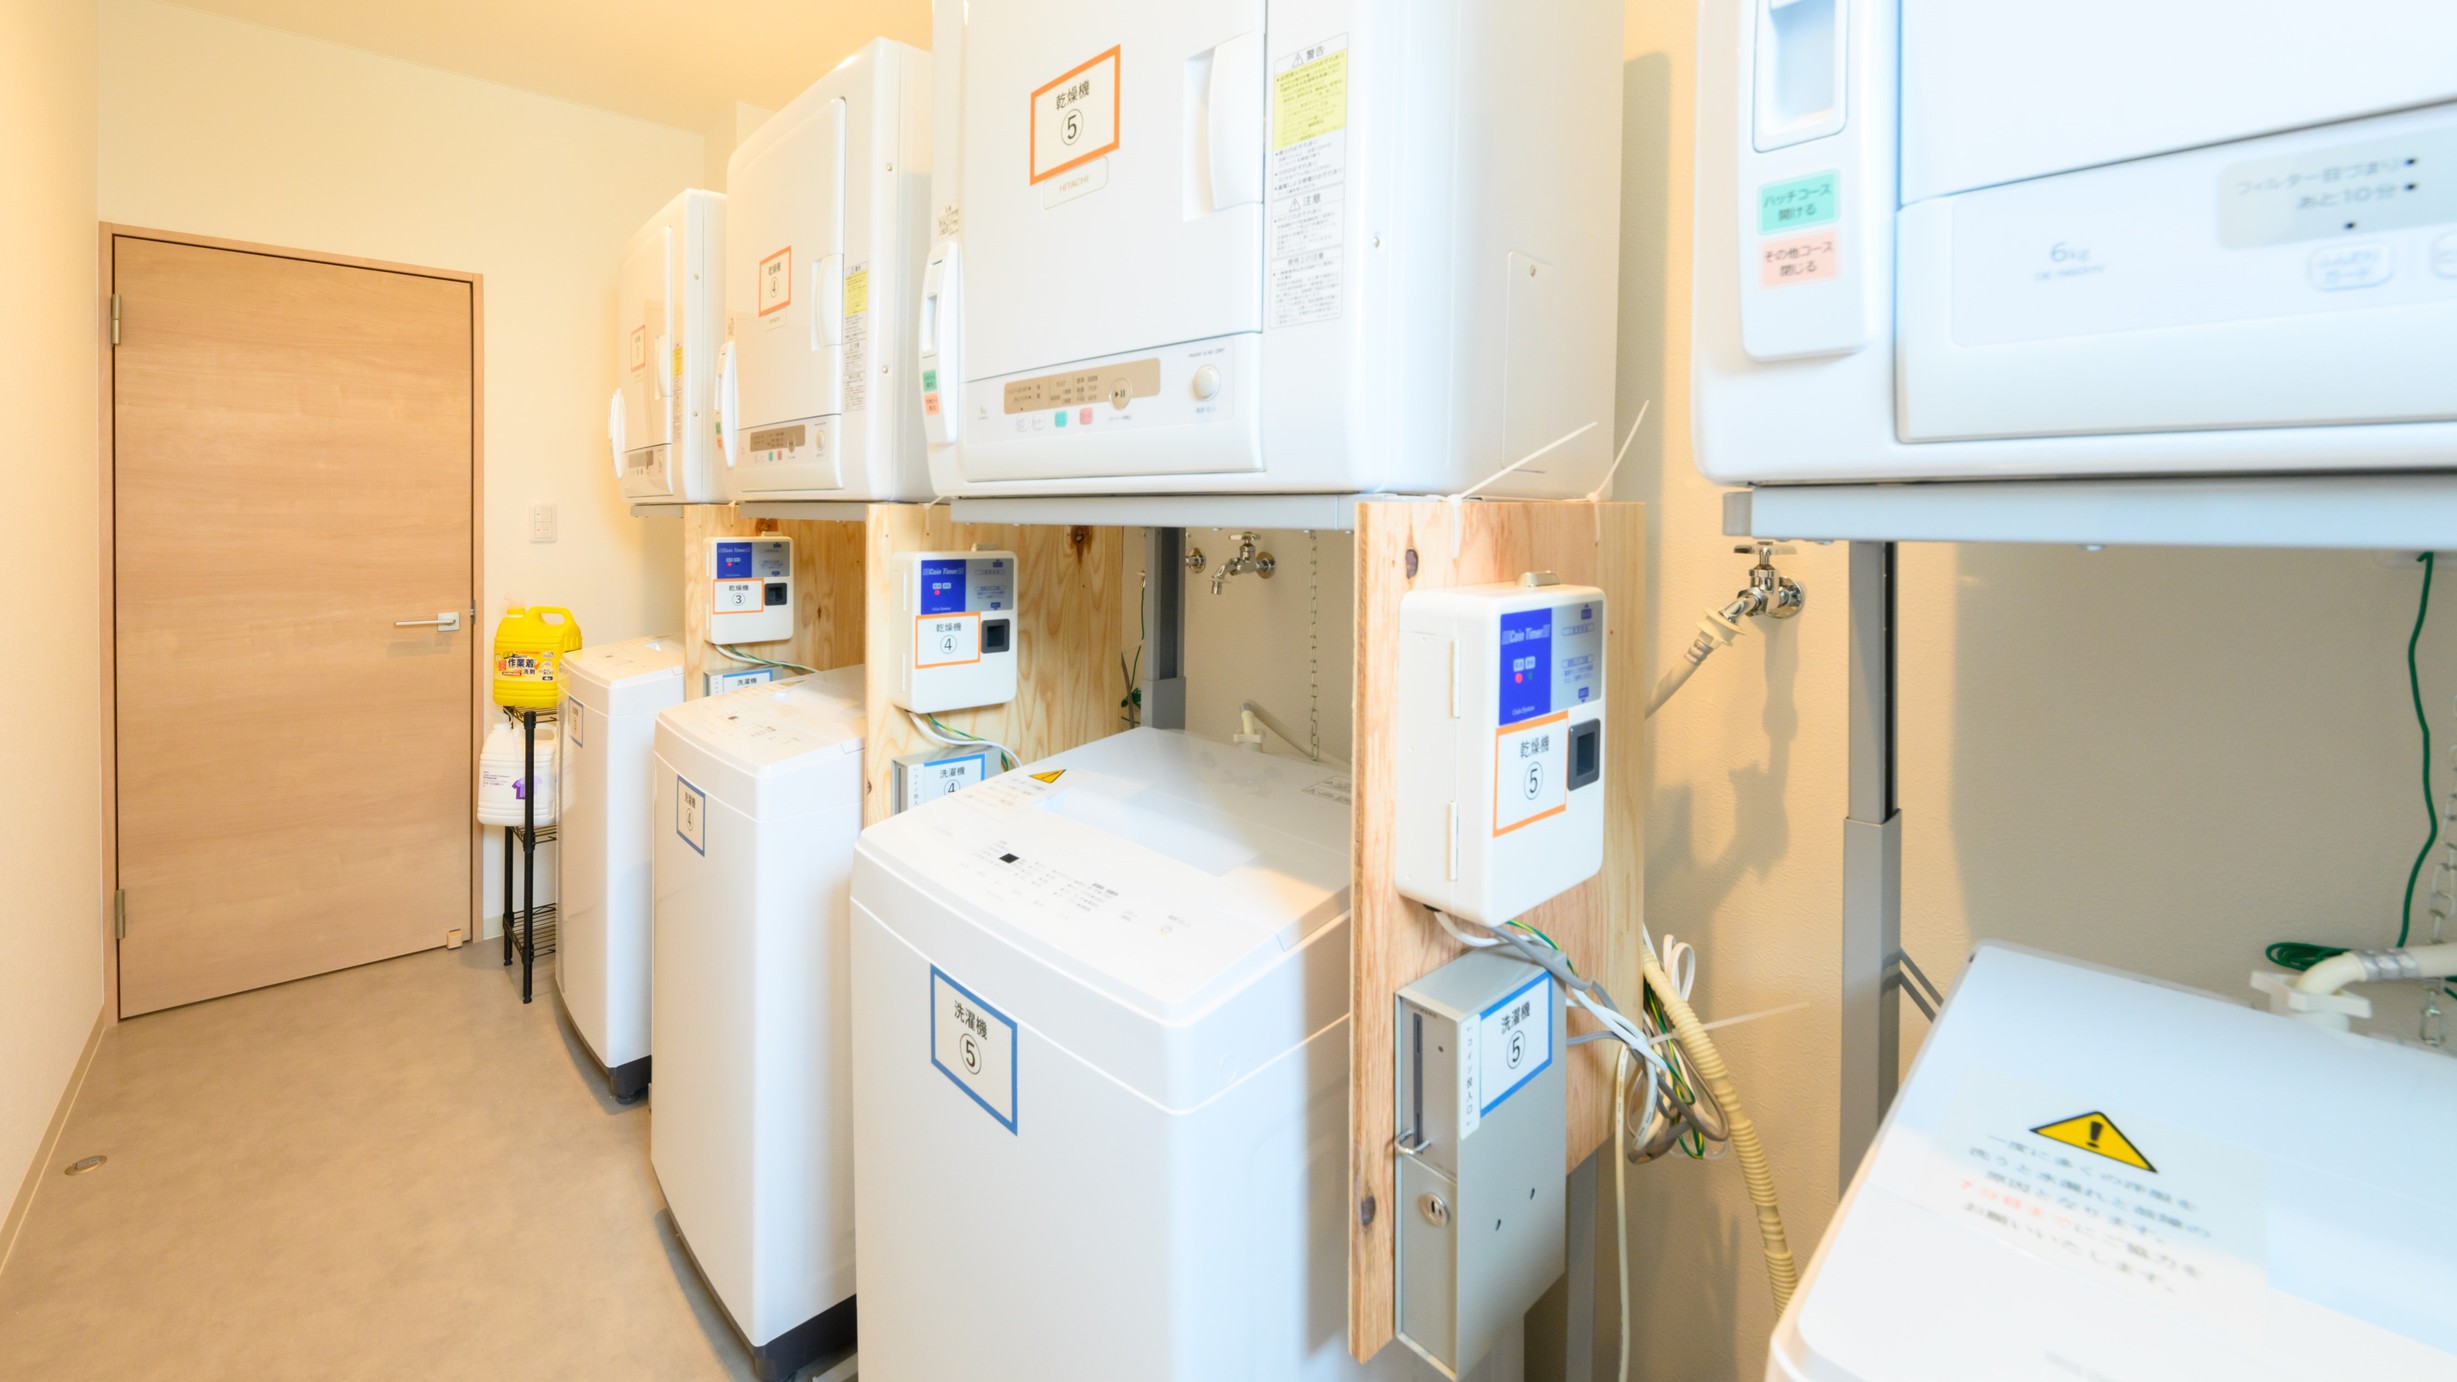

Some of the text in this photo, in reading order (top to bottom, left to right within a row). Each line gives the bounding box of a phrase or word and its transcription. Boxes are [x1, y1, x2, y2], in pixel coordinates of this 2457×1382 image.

[1306, 45, 1324, 61] 警告
[1056, 79, 1090, 110] 乾燥機
[1059, 174, 1089, 192] HITACHI
[1302, 193, 1321, 206] 注意
[1764, 183, 1832, 208] ハッチコース
[2297, 183, 2396, 210] あと10分
[1778, 203, 1817, 222] 開ける
[1765, 241, 1834, 263] その他コース
[1780, 261, 1817, 278] 閉じる
[928, 568, 942, 576] Coin
[729, 584, 749, 592] 乾燥機
[936, 622, 962, 633] 乾燥機
[1509, 626, 1544, 644] Coin Timer
[508, 658, 535, 669] 作業着
[737, 677, 757, 686] 洗濯機
[1520, 734, 1550, 758] 乾燥機
[940, 766, 965, 779] 洗濯機
[954, 999, 988, 1041] 洗濯機
[1501, 1001, 1530, 1035] 洗濯機
[1962, 1202, 2176, 1293] お願いいたします。
